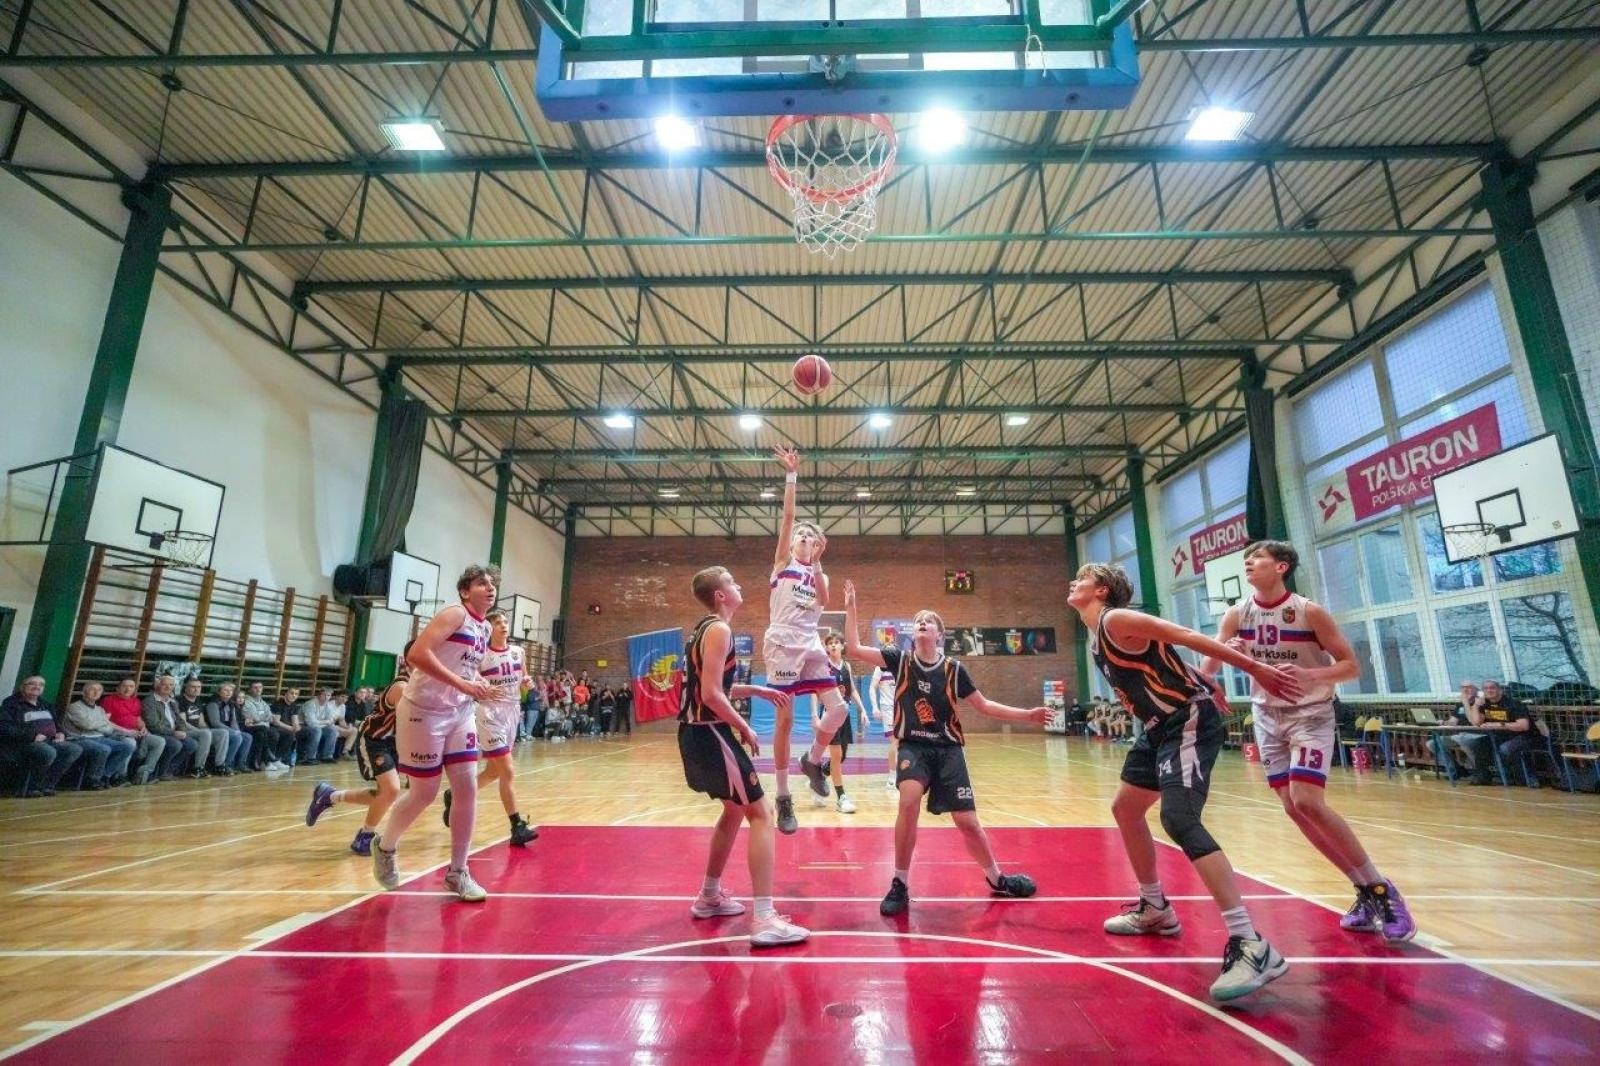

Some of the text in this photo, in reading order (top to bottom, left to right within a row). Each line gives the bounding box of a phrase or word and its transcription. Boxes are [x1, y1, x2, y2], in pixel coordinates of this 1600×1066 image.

[1360, 424, 1479, 492] TAURON
[1371, 480, 1417, 508] POLSKA
[1192, 518, 1250, 557] TAURON
[1257, 624, 1279, 646] 13
[501, 661, 511, 677] 11
[917, 680, 932, 694] 22
[410, 751, 439, 762] Marko
[1297, 747, 1324, 770] 13
[957, 786, 972, 800] 22
